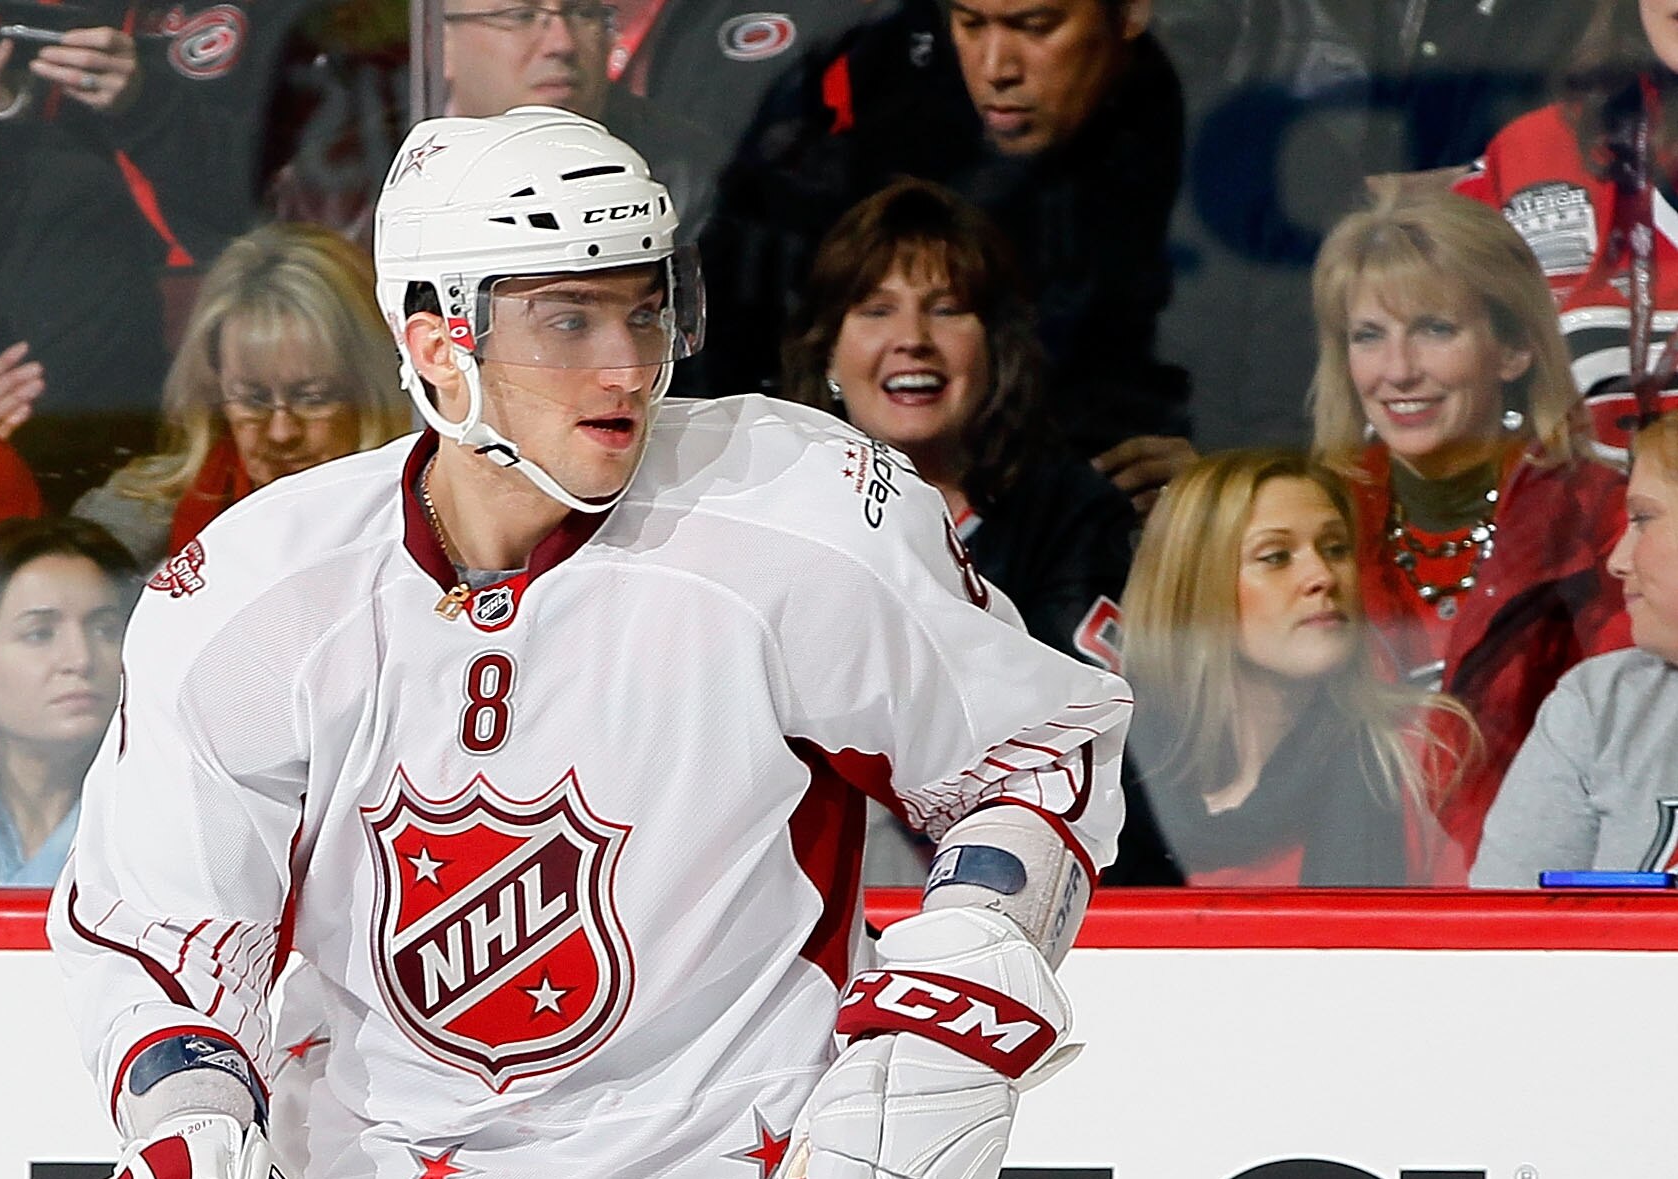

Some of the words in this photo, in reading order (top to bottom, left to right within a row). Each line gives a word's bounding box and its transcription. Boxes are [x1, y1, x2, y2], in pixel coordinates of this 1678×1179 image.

[583, 202, 650, 224] CCM
[480, 592, 508, 619] NHL
[458, 648, 518, 757] 8
[416, 862, 568, 1010] NHL
[844, 971, 1042, 1054] CCM
